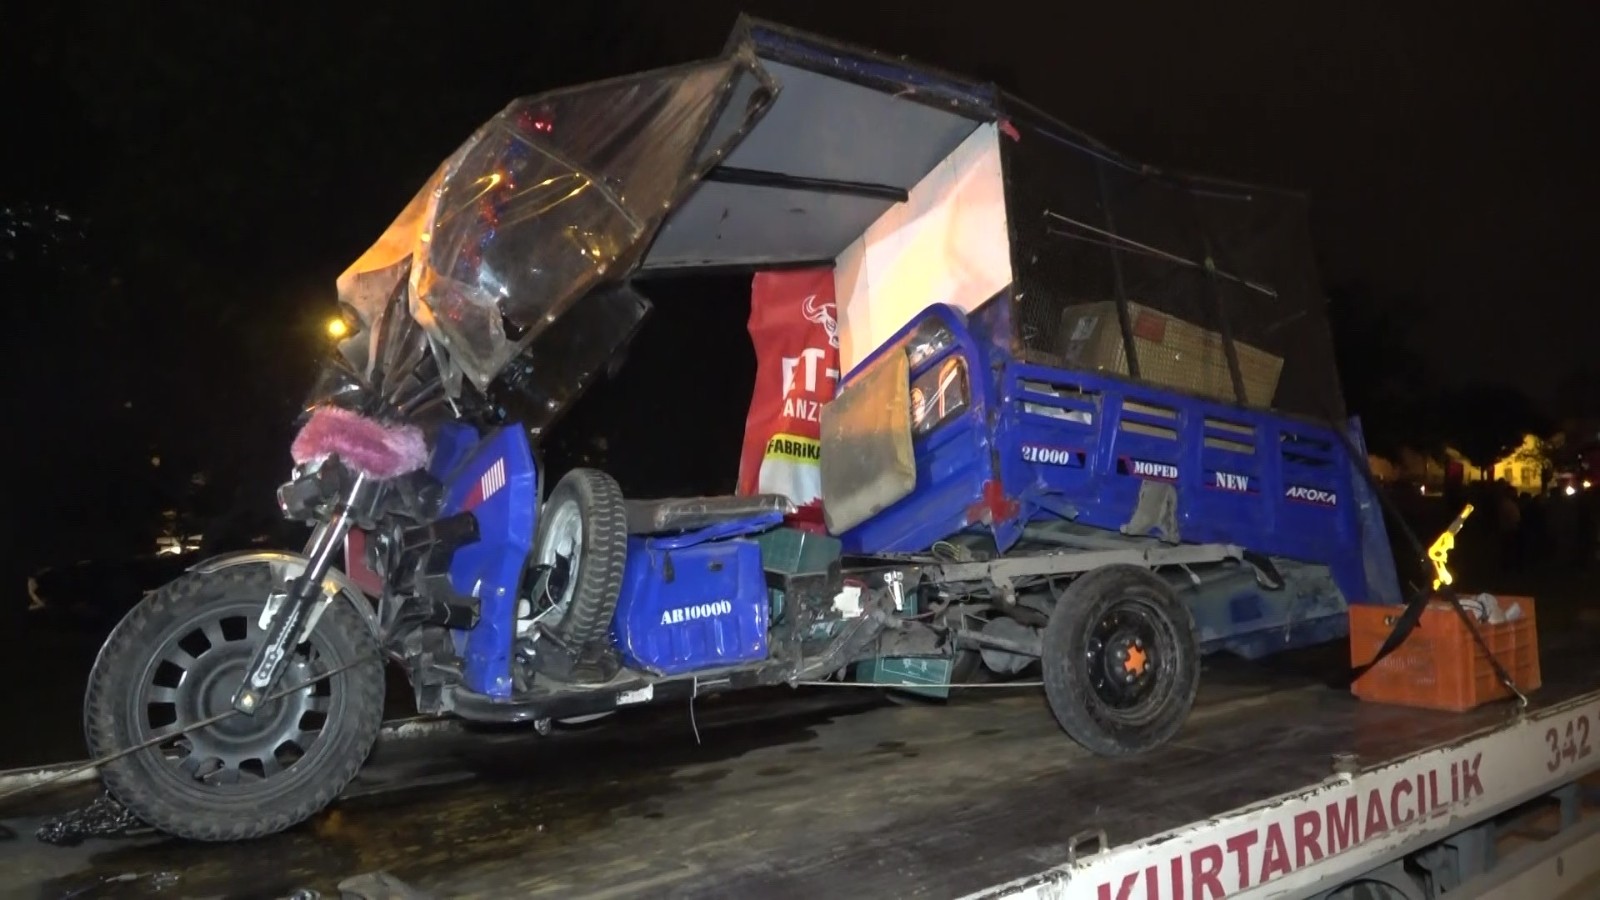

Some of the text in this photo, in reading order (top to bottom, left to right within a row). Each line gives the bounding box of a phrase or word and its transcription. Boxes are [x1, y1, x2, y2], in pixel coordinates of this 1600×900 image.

[1021, 445, 1070, 465] 21000
[1134, 460, 1178, 479] MOPED
[1215, 471, 1250, 492] NEW
[660, 599, 732, 625] AR10000
[1545, 715, 1592, 773] 342
